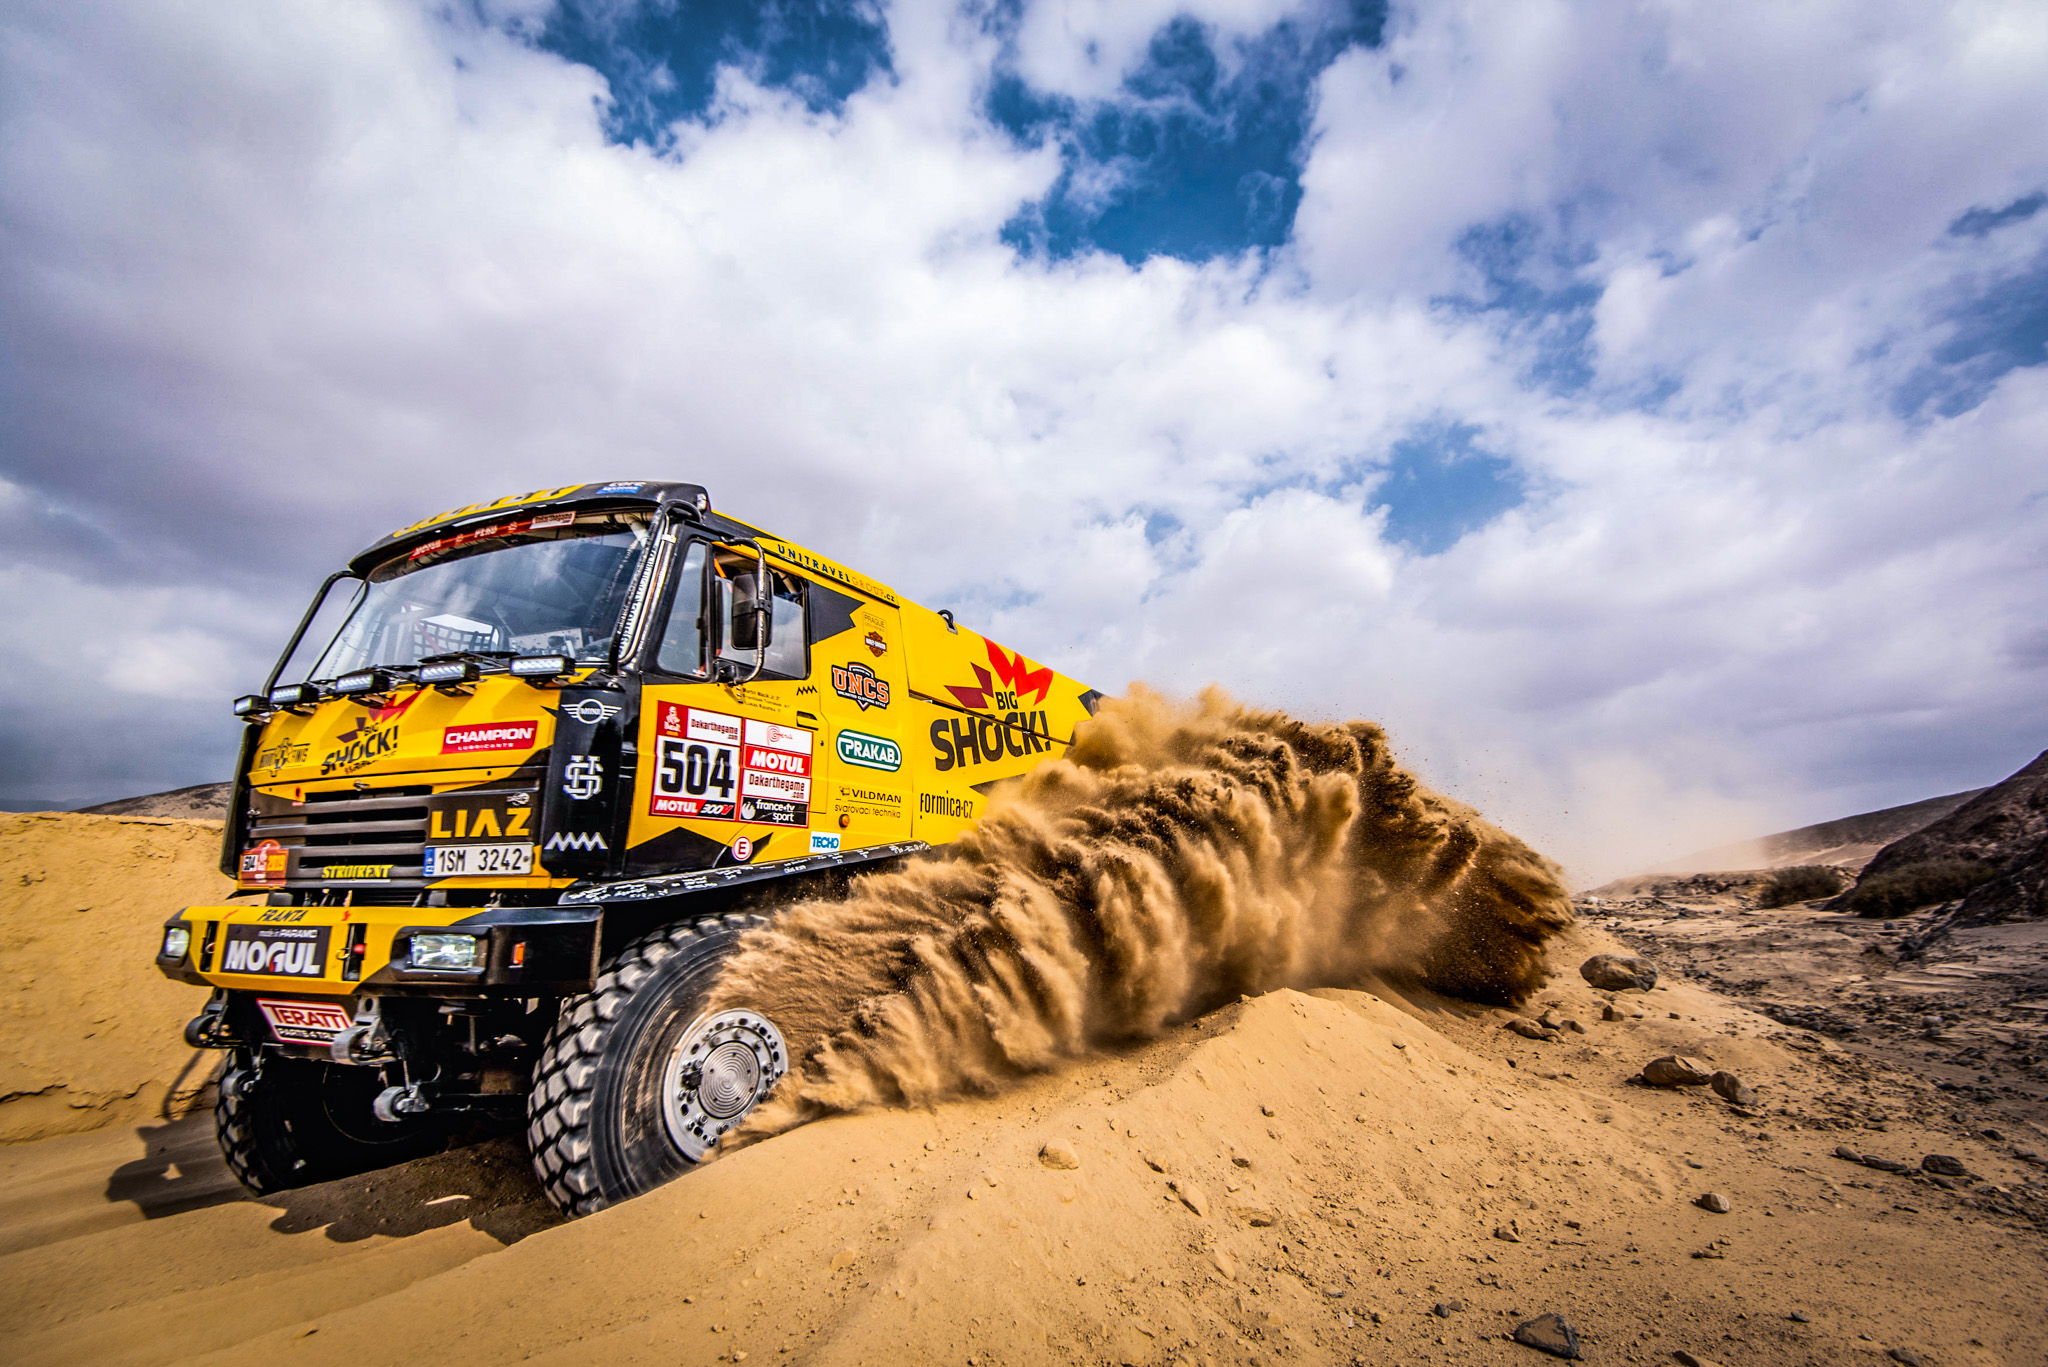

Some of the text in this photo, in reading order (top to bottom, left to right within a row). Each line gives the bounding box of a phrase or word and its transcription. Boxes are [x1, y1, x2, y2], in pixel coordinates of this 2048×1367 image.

[832, 667, 889, 704] UNCS
[995, 690, 1019, 711] BIG
[363, 722, 380, 737] BIG
[445, 727, 535, 744] CHAMPION
[690, 718, 738, 735] Dakarthegame
[457, 742, 514, 751] LUBRICANTS
[930, 710, 1052, 772] SHOCK!
[320, 725, 399, 776] SHOCK!
[660, 740, 735, 798] 504
[750, 750, 805, 774] MOTUL
[749, 773, 805, 792] Dakarthegame
[851, 788, 902, 804] VILDMAN
[655, 799, 734, 815] MOTUL 300V
[872, 807, 901, 819] technika
[772, 812, 795, 823] sport
[738, 841, 747, 855] E
[811, 836, 839, 849] TECHO
[438, 848, 523, 873] 1SM 3242
[224, 940, 321, 975] MOGUL
[261, 1003, 350, 1029] TERATTI
